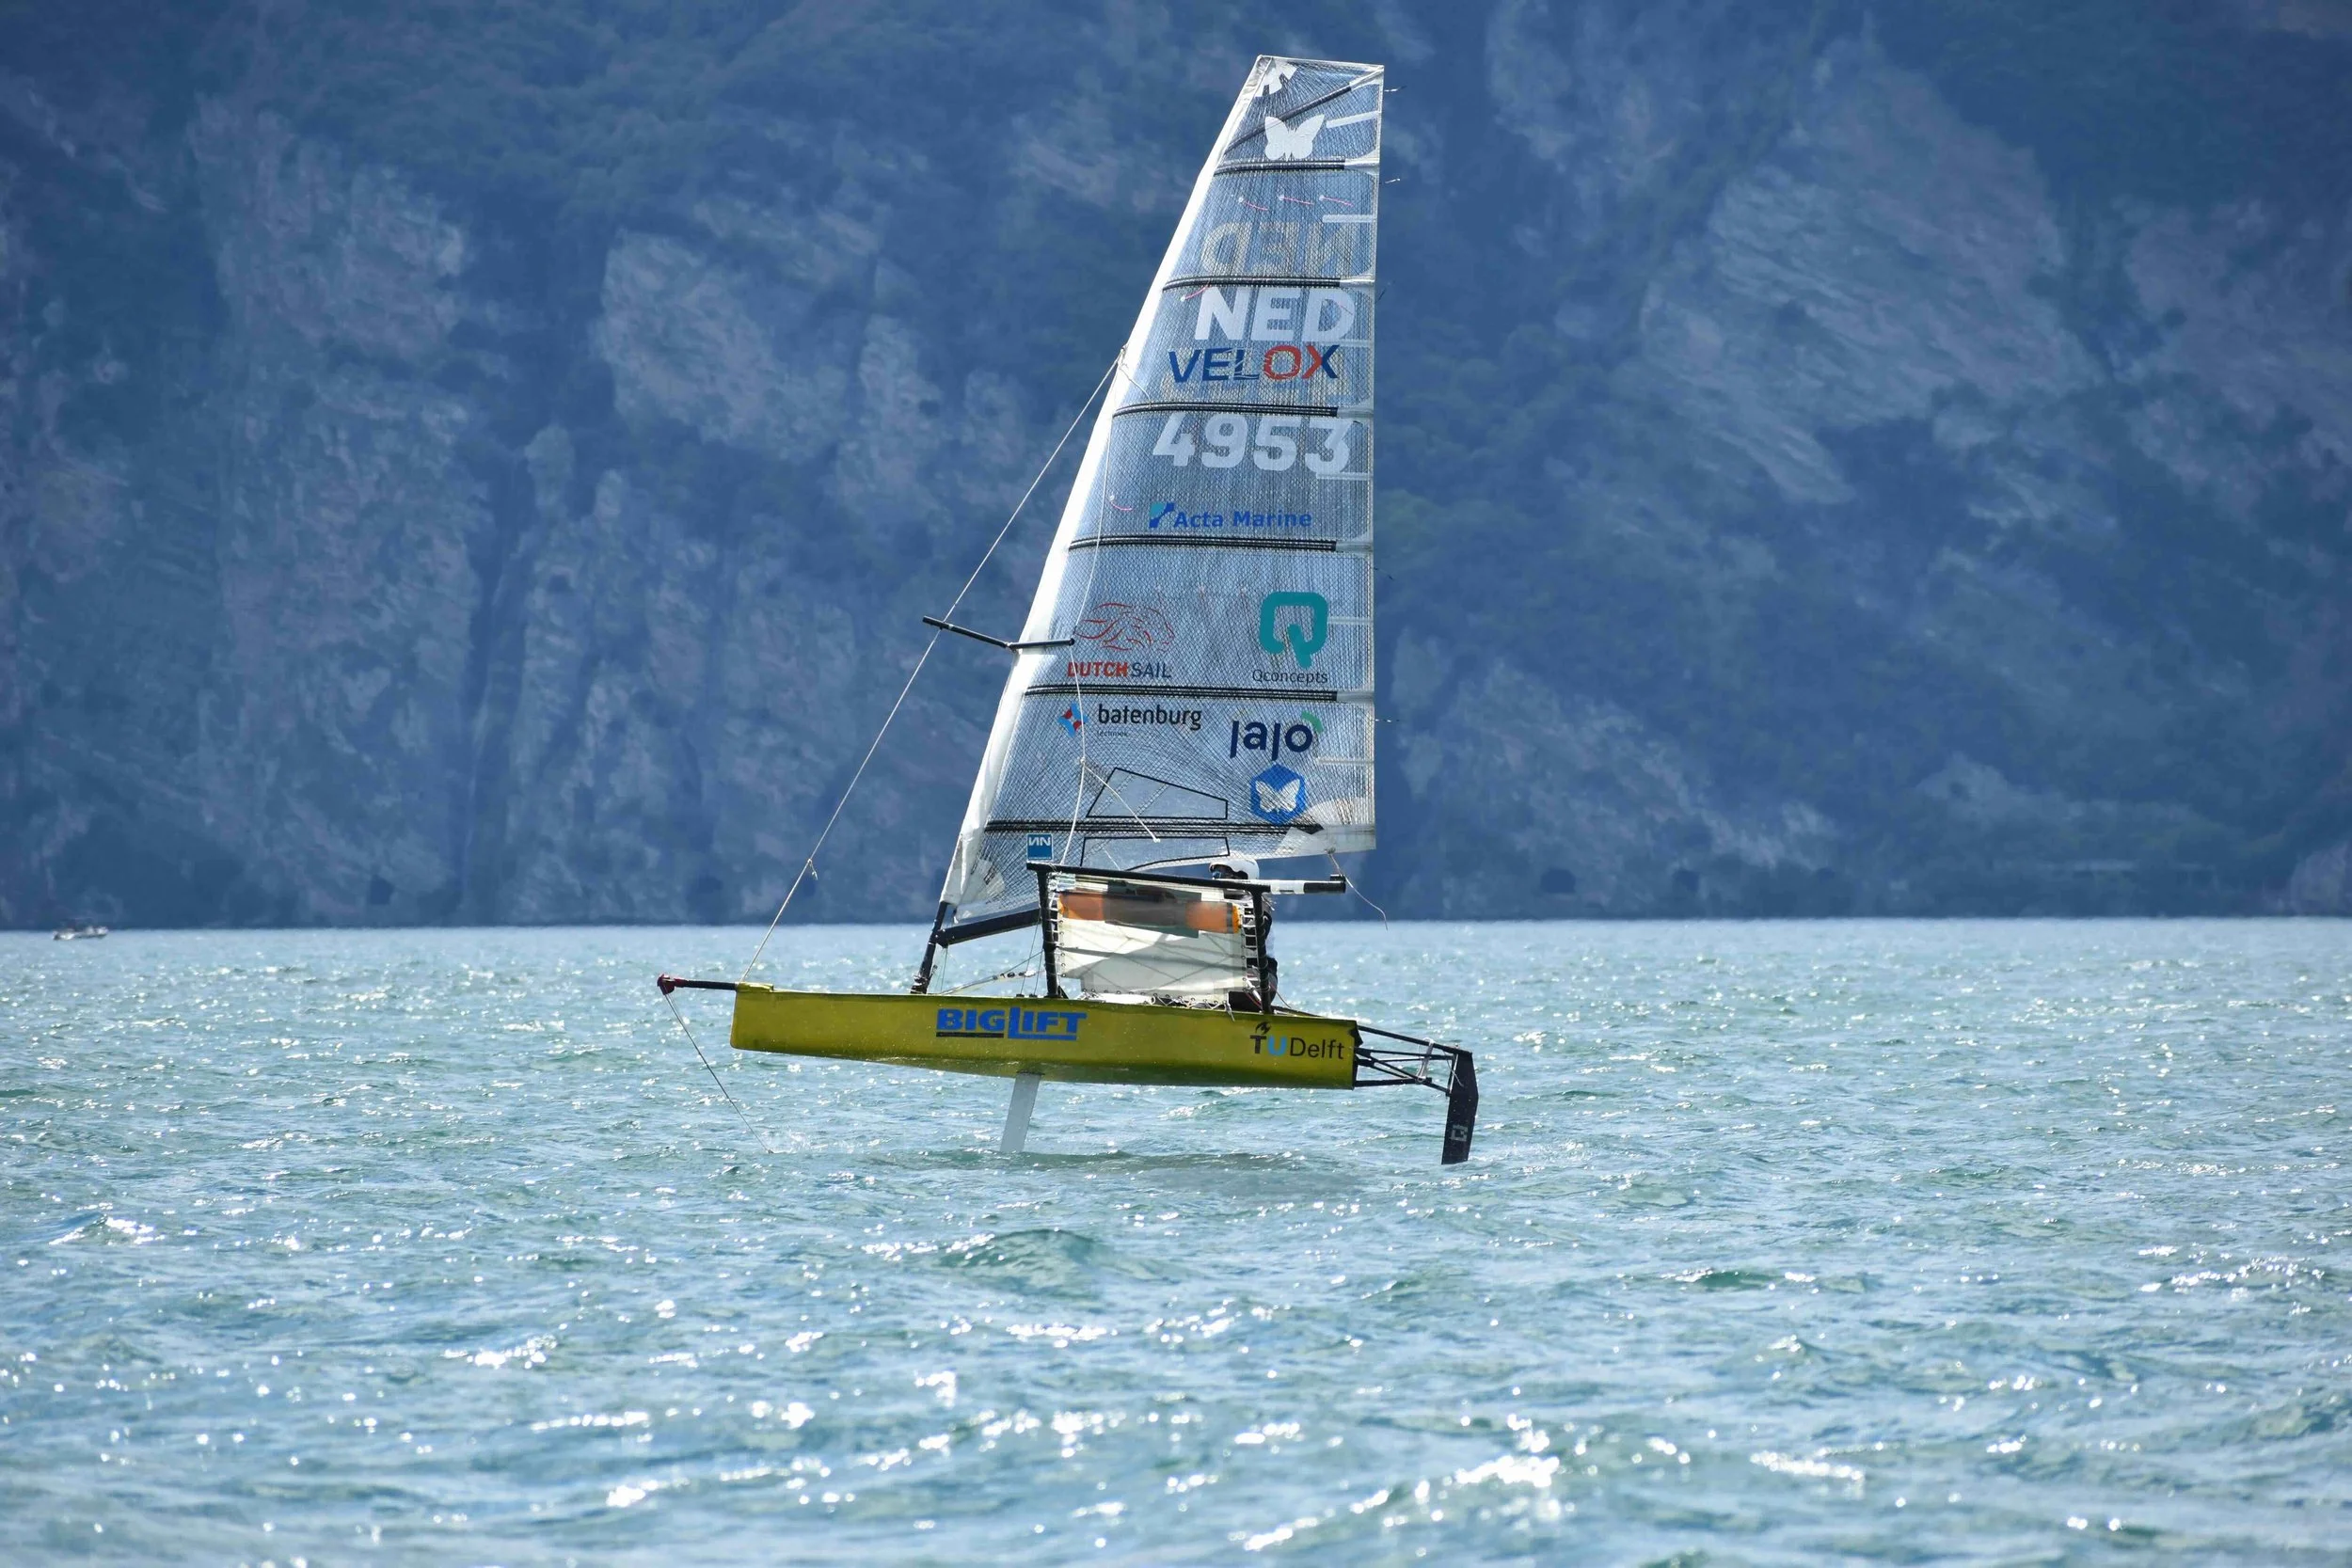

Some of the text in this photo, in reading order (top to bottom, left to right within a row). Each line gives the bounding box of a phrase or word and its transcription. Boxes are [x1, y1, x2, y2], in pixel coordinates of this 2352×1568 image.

[1194, 286, 1356, 342] NED
[1168, 344, 1340, 383] VELOX
[1152, 414, 1351, 473] 4953
[1174, 510, 1312, 528] Acta Marine
[1252, 669, 1328, 685] Qconcepts
[1098, 704, 1202, 731] batenburg
[1290, 1037, 1345, 1060] Delft
